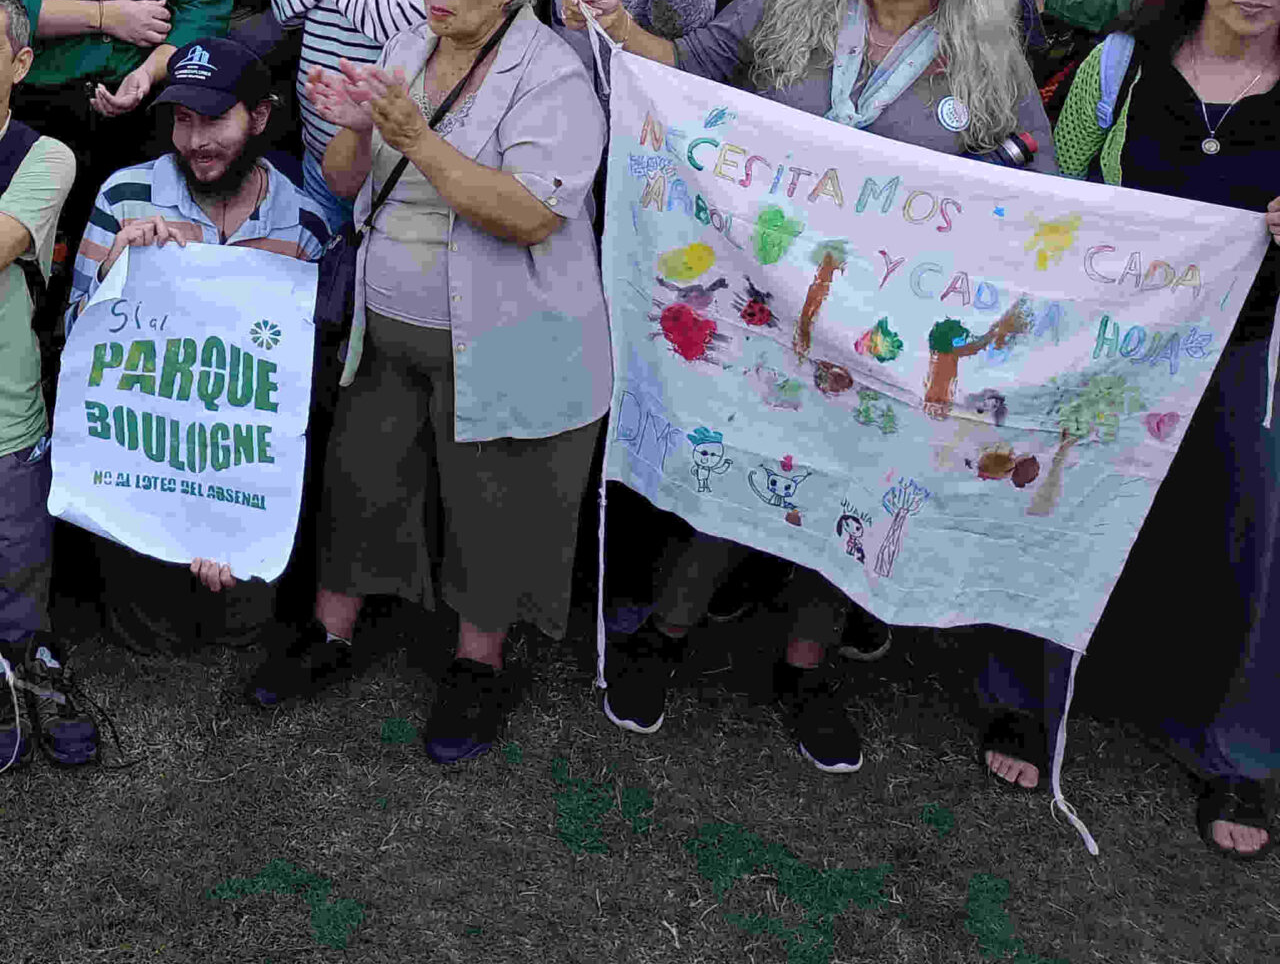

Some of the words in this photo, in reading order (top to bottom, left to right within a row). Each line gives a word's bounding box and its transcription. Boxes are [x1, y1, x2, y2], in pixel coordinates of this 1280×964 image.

[639, 111, 963, 233] NECESITAMOS
[1084, 244, 1202, 300] CADA
[878, 250, 906, 290] Y
[149, 314, 168, 331] al
[87, 335, 279, 413] PARQUE
[85, 399, 275, 474] BOULOGNE
[93, 470, 112, 485] NO
[115, 471, 131, 487] AL
[135, 474, 177, 493] LOTEO
[180, 479, 204, 497] DEL
[206, 484, 267, 511] ARSENAL
